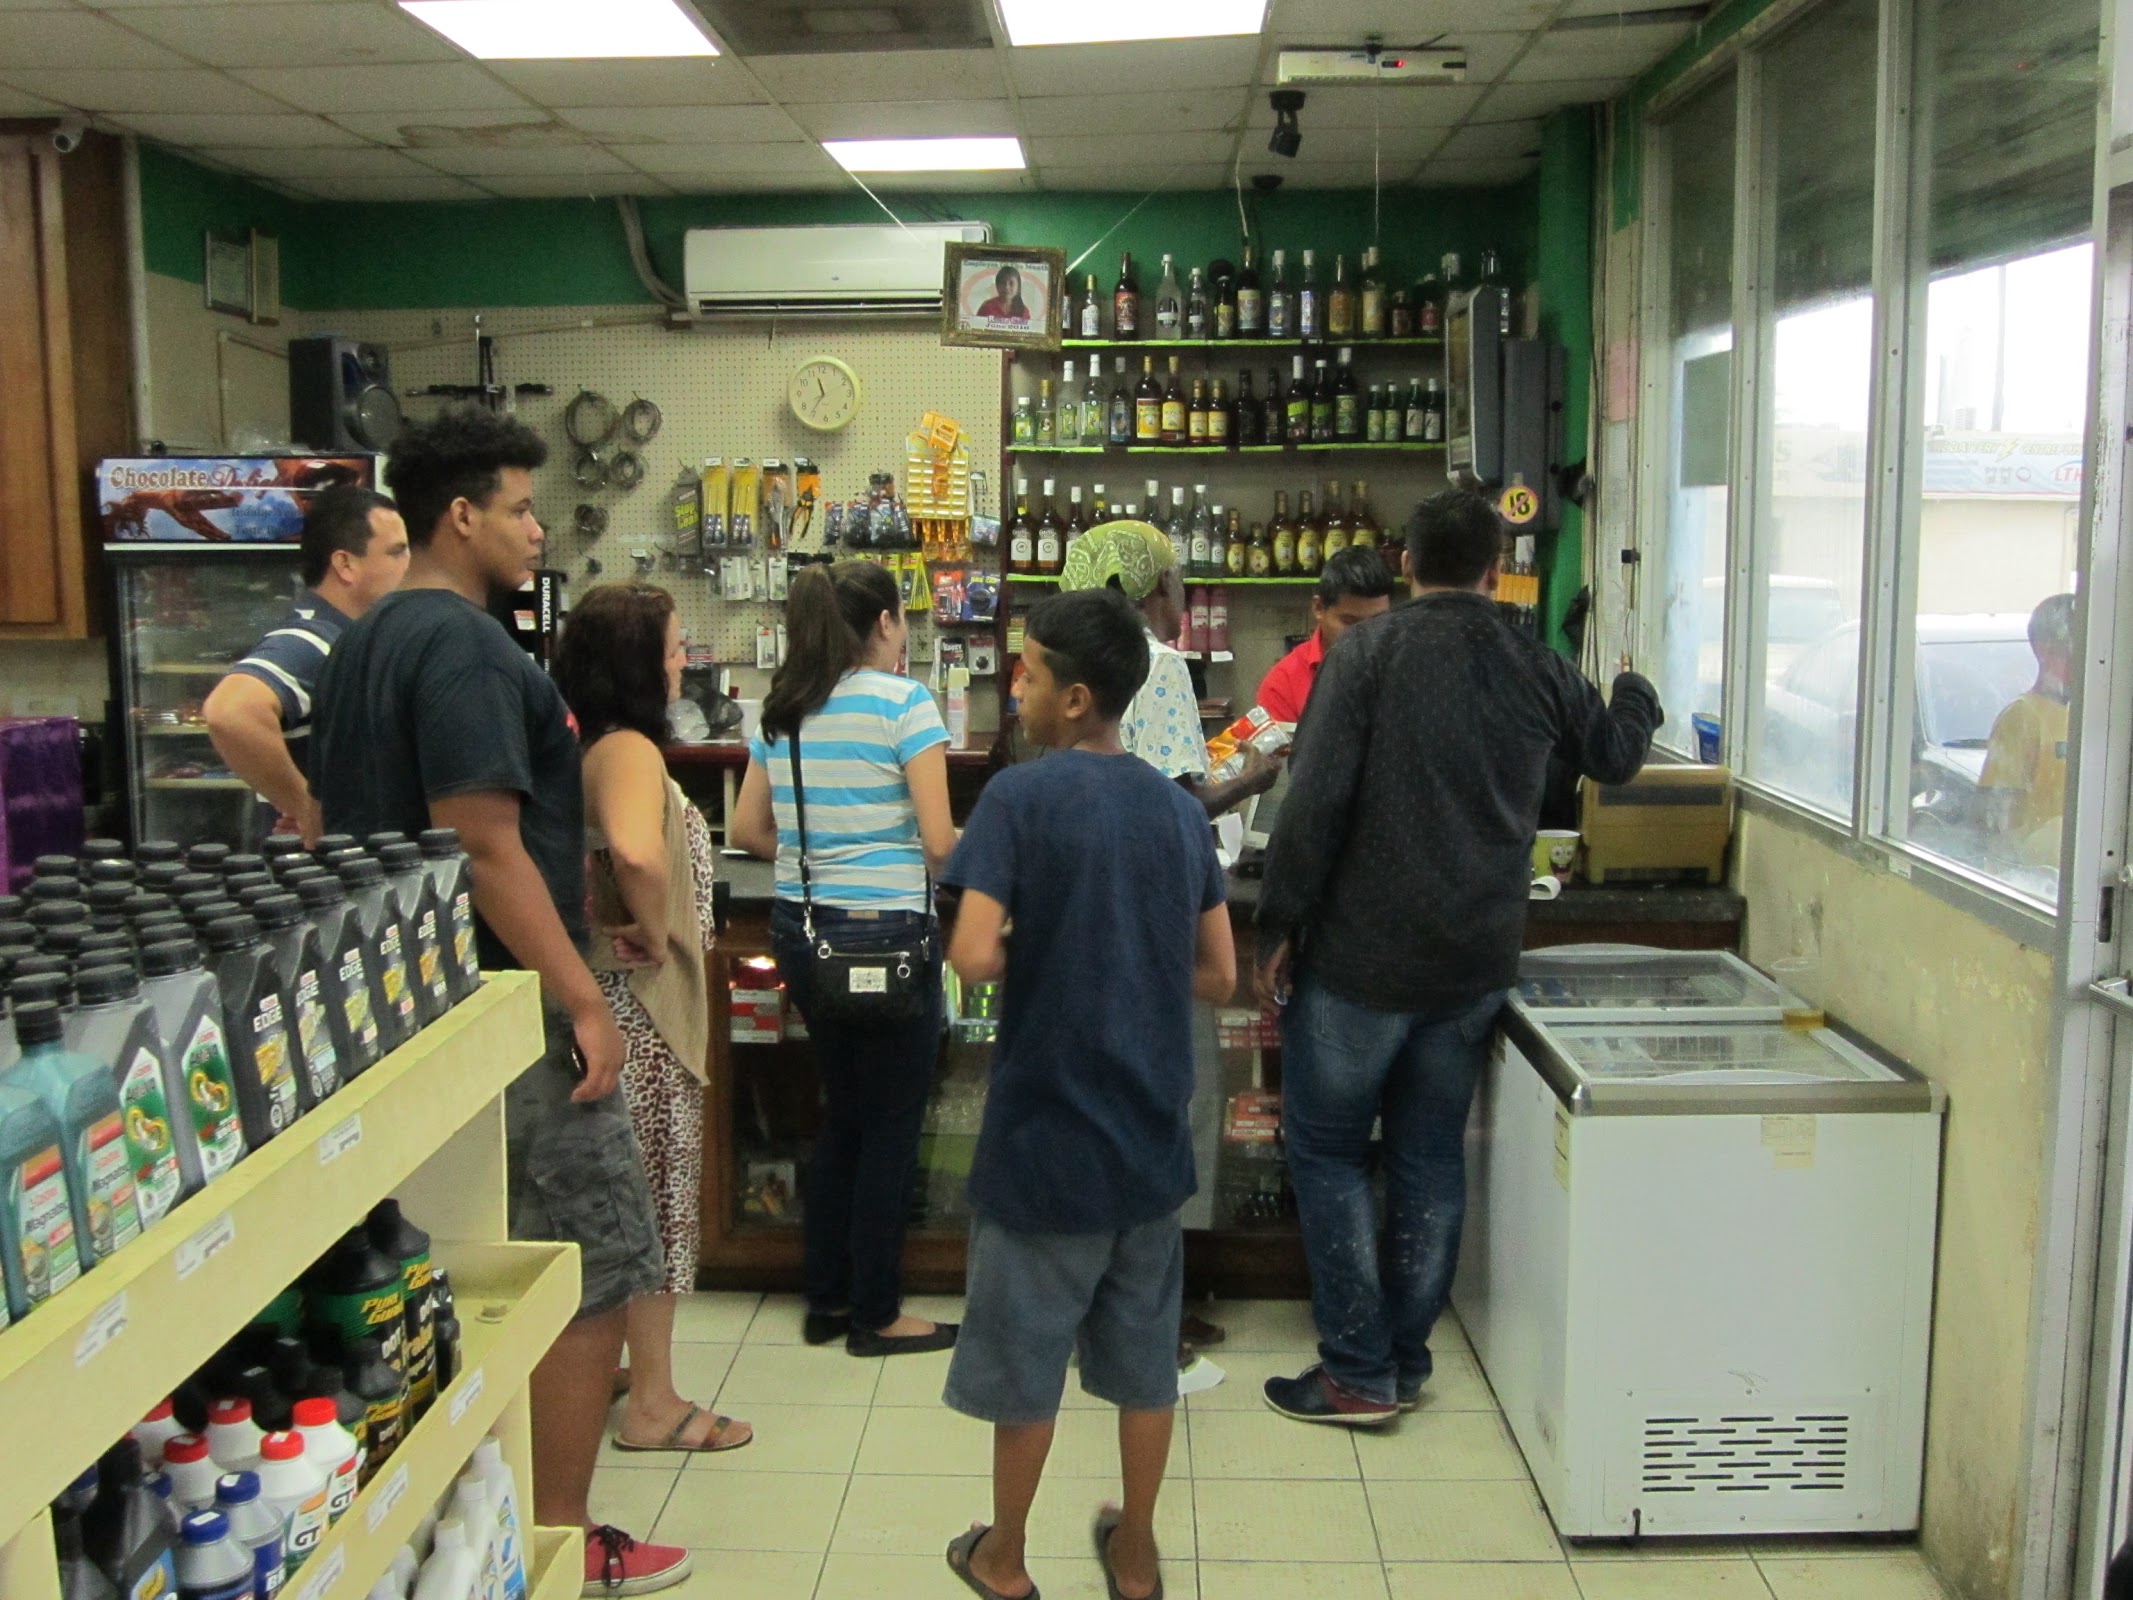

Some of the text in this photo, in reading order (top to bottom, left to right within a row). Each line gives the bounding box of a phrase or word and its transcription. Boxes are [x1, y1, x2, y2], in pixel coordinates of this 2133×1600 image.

[110, 466, 207, 488] Chocolate
[542, 577, 551, 633] DURACELL
[339, 958, 364, 981] EDGE
[253, 1005, 283, 1032] EDGE
